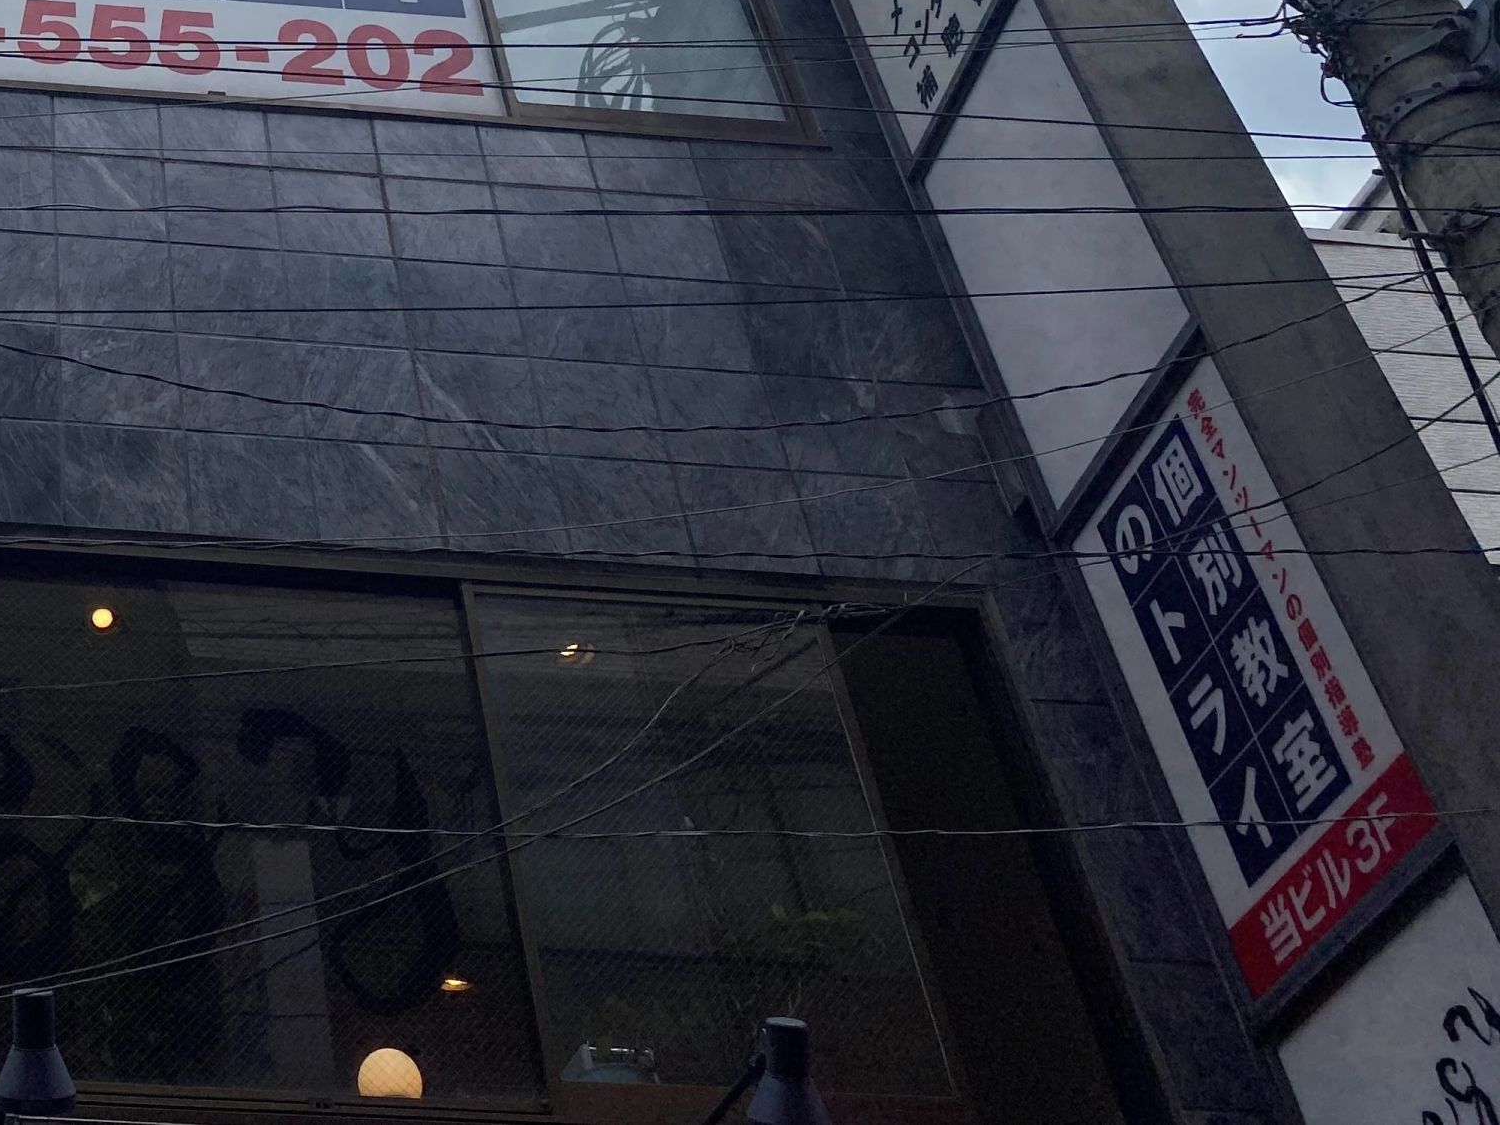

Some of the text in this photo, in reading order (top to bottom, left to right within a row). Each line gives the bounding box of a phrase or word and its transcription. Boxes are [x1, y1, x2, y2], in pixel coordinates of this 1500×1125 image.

[1114, 504, 1274, 849] のトライ
[1152, 431, 1341, 806] 個別教室
